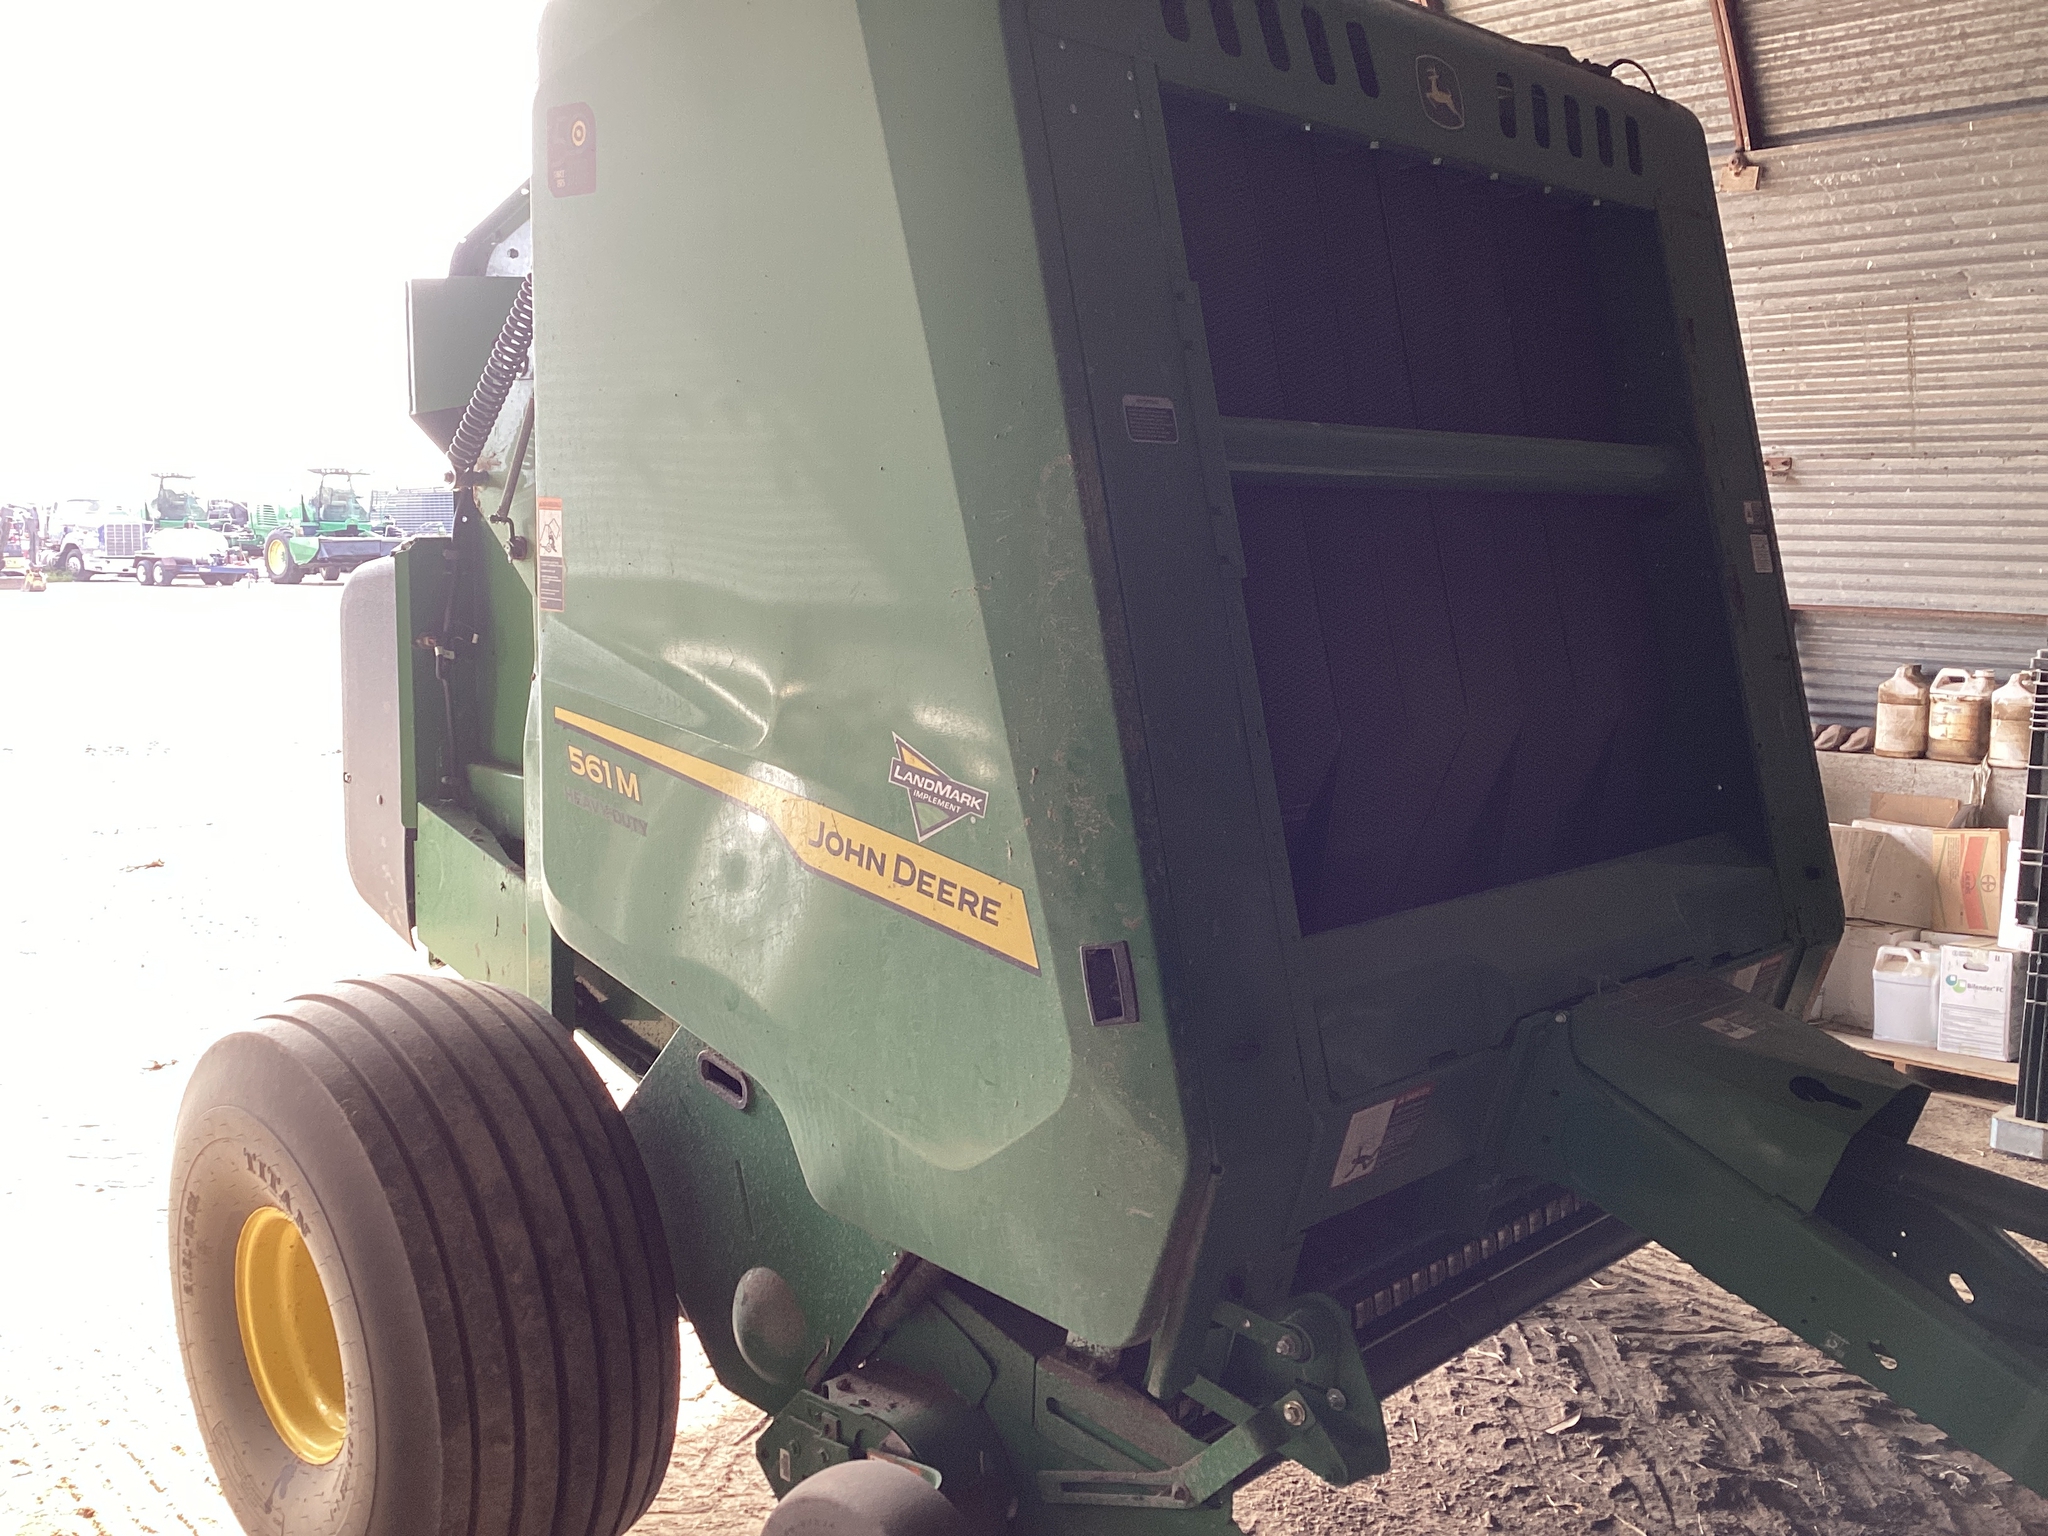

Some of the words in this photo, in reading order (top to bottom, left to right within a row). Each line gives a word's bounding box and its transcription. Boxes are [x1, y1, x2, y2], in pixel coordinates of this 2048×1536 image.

[893, 764, 984, 811] LANDMARK
[913, 789, 962, 814] IMPLEMENT
[808, 811, 887, 877] JOHN
[893, 853, 1002, 928] DEERE
[243, 1147, 311, 1238] TITAN
